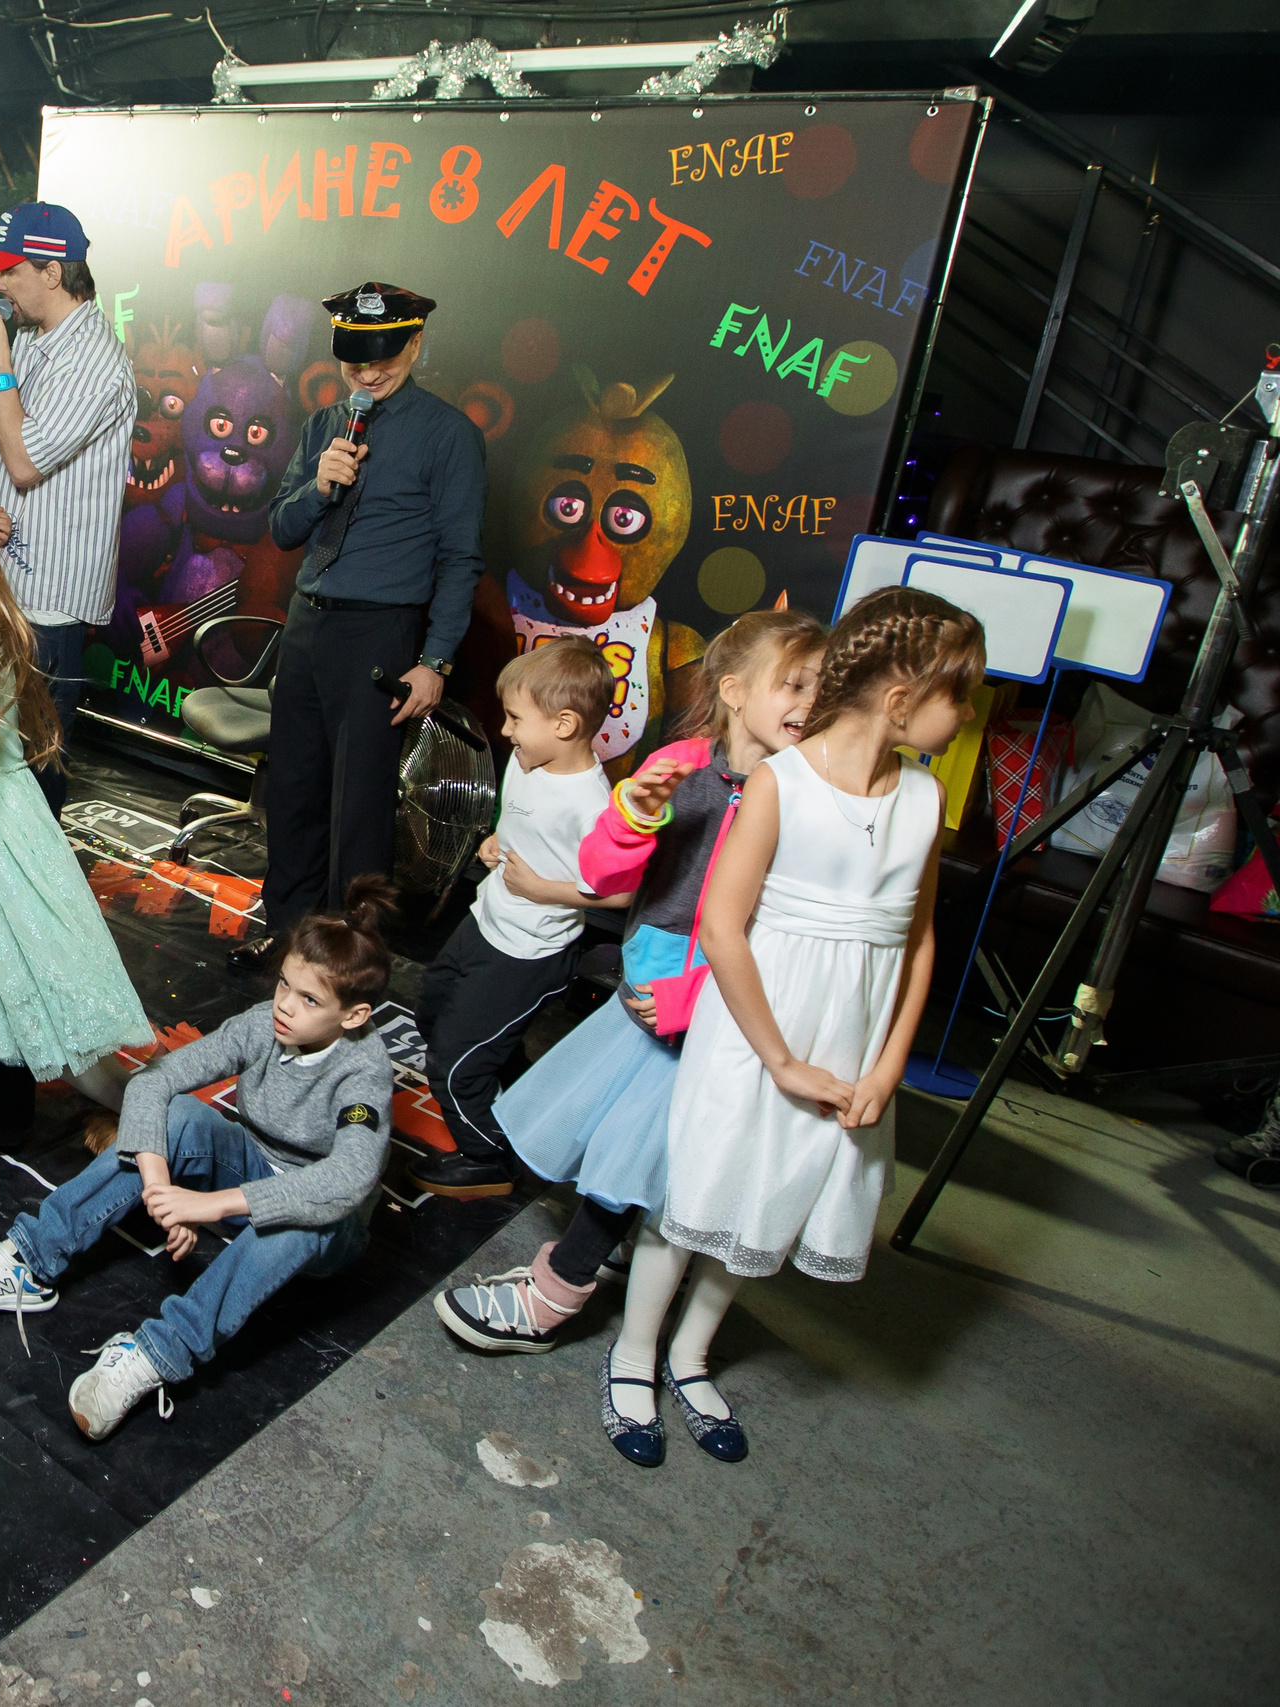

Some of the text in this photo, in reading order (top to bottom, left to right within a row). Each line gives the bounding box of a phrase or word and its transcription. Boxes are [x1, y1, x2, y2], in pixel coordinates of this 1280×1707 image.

[668, 131, 794, 186] FNAF
[164, 142, 713, 296] АРИНЕ 8 ЛЕТ
[793, 239, 930, 317] FNAF
[709, 302, 871, 398] FNAF
[711, 494, 837, 535] FNAF
[84, 804, 139, 828] CAM
